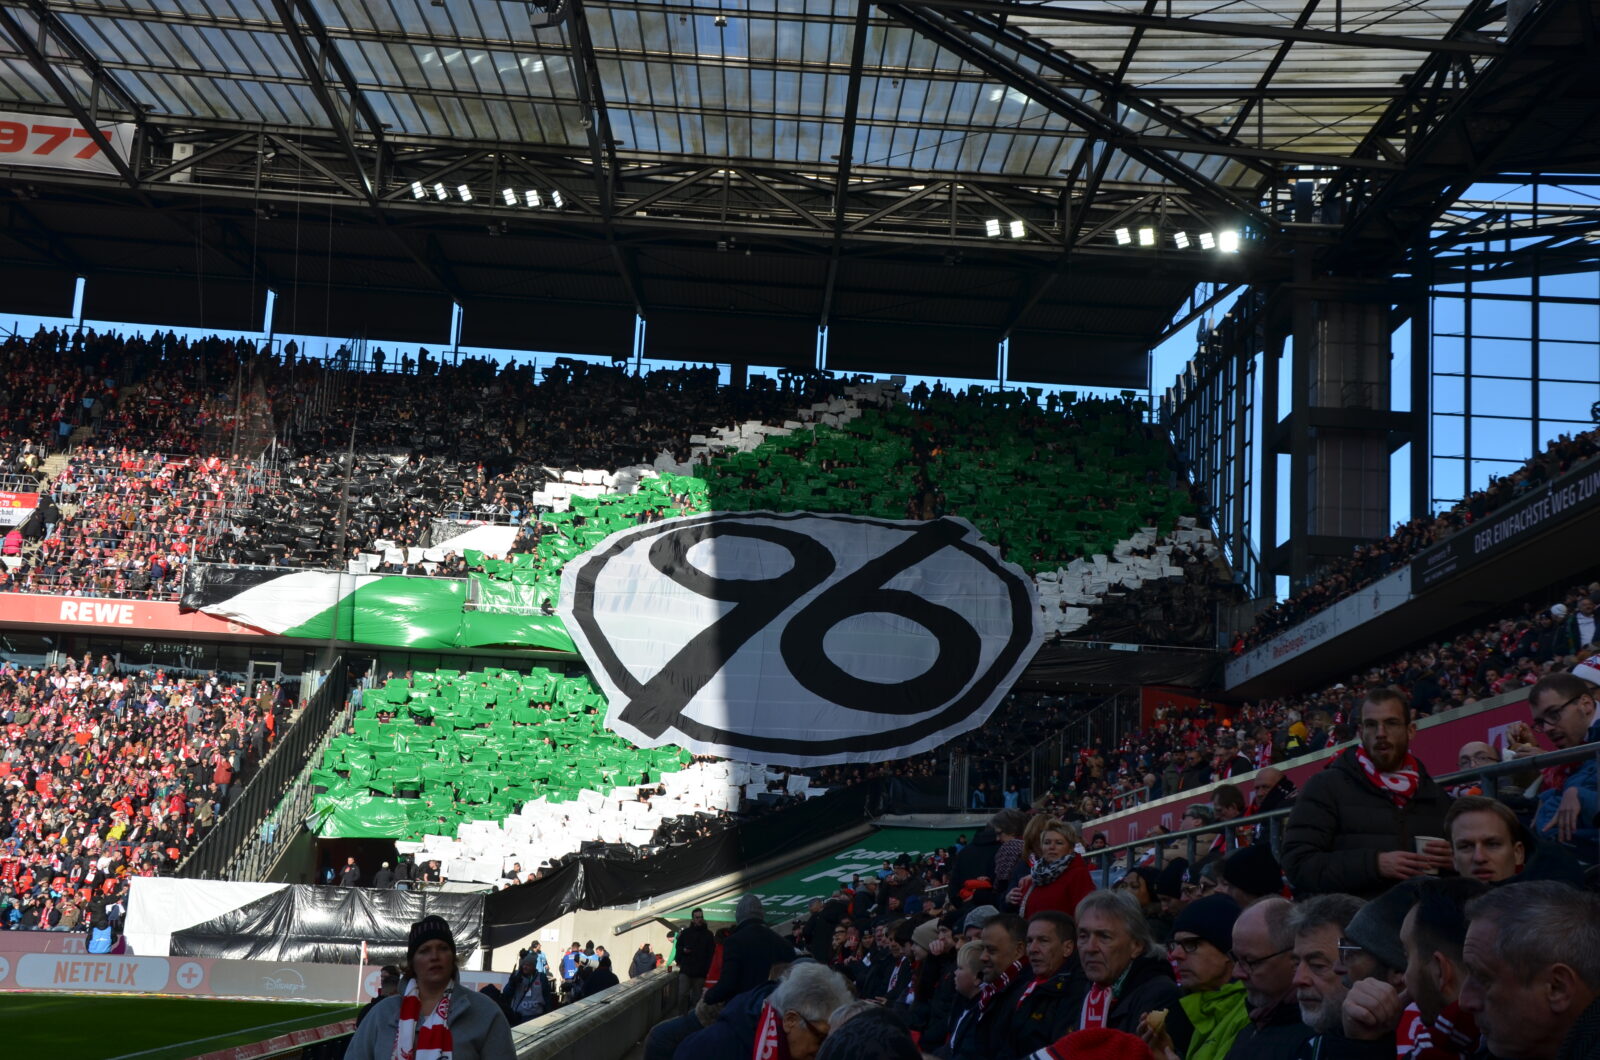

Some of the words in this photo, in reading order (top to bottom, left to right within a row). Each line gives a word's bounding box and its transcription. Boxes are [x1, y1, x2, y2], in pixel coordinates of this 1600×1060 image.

[1474, 528, 1493, 554] DER
[1494, 498, 1551, 544] EINFACHSTE
[1551, 484, 1576, 515] WEG
[60, 601, 135, 624] REWE
[53, 960, 139, 986] NETFLIX
